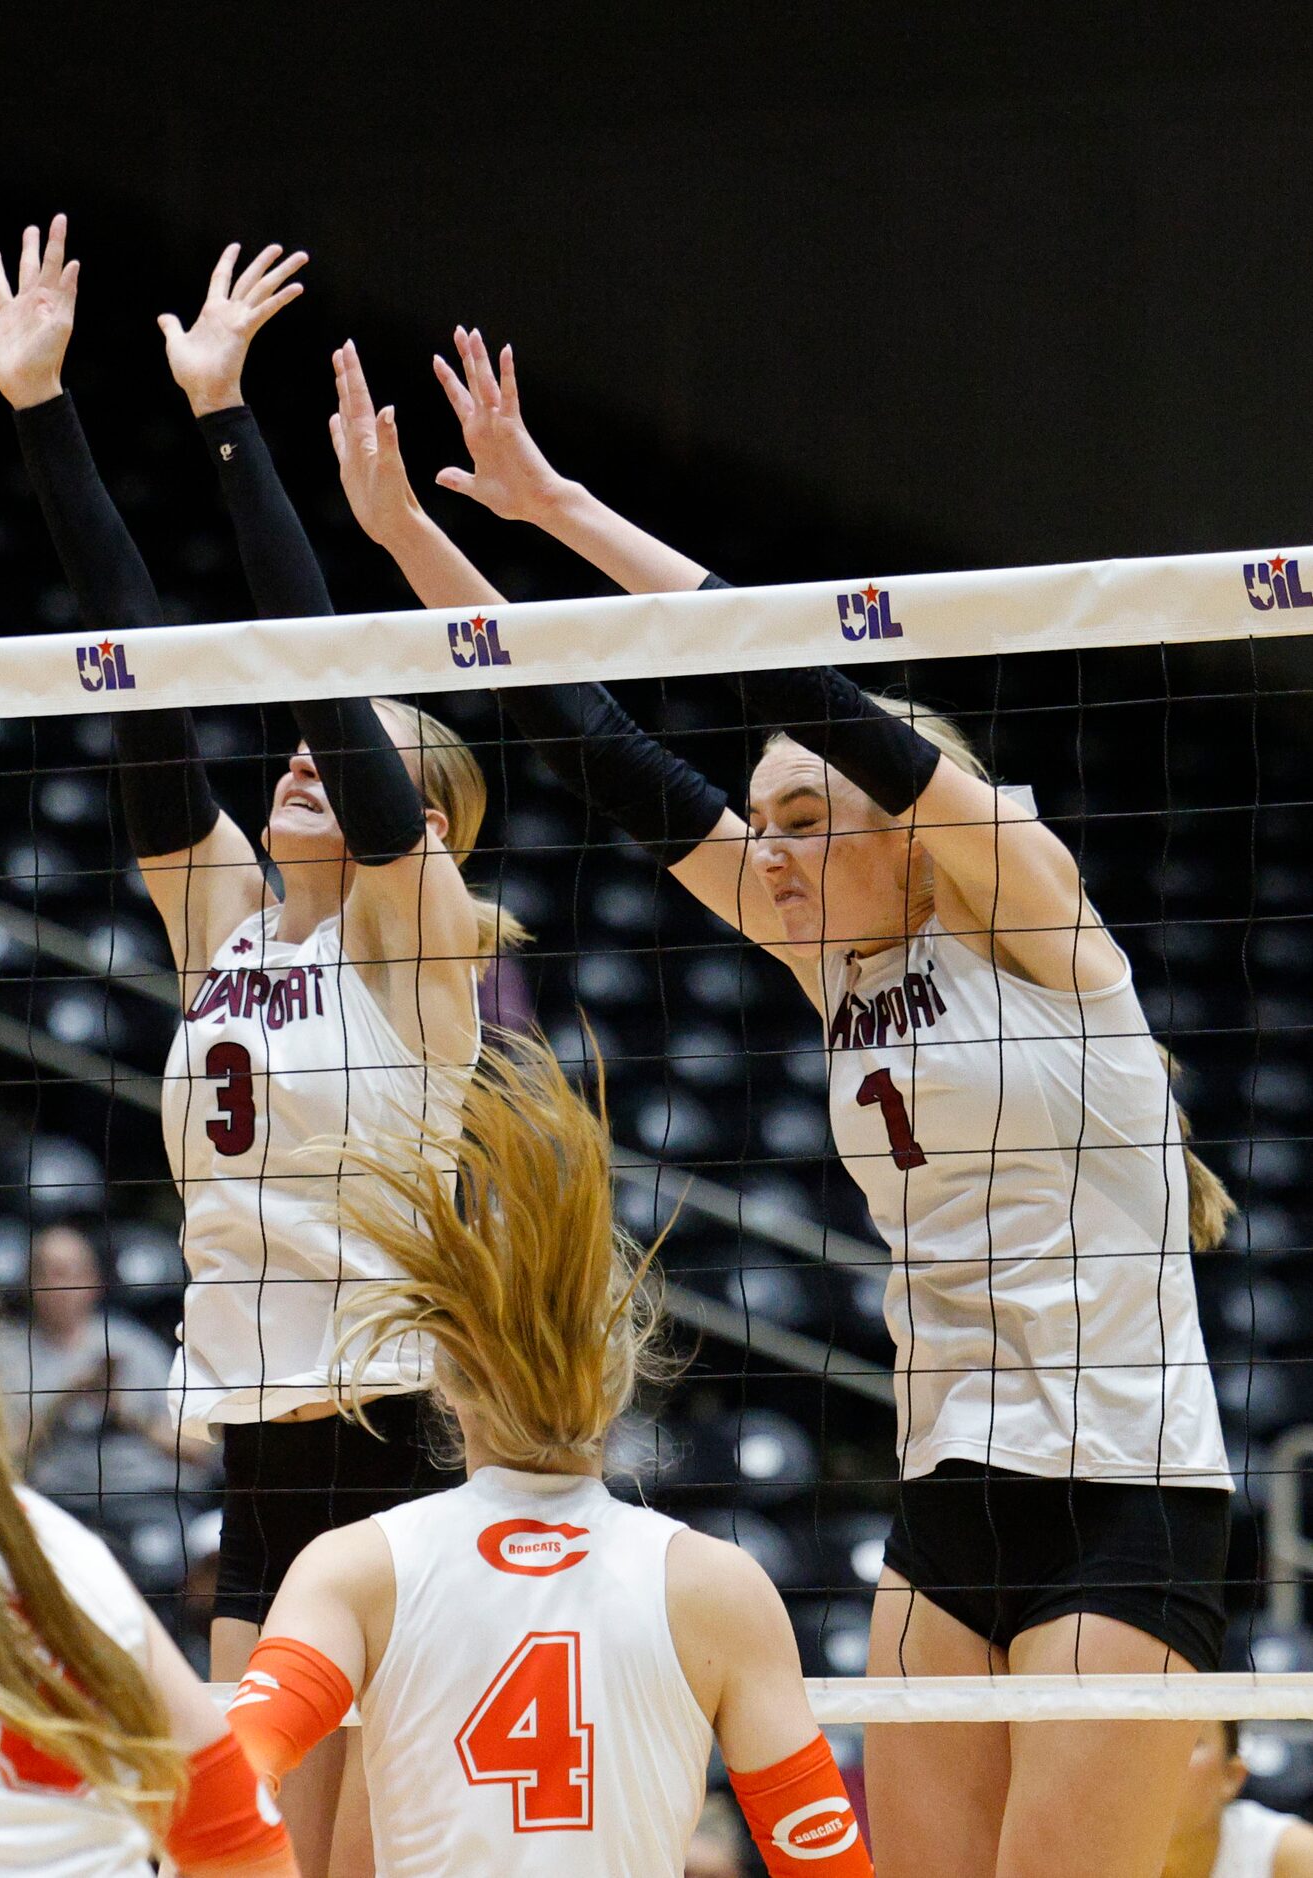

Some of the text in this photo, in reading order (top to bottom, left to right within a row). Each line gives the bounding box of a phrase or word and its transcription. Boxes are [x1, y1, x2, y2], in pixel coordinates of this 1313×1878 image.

[447, 612, 512, 669] UIL
[837, 582, 903, 641] UIL
[76, 637, 136, 692] UIL
[206, 1042, 256, 1157] 3
[856, 1068, 928, 1171] 1
[508, 1541, 562, 1555] BOBCATS
[454, 1631, 594, 1833] 4
